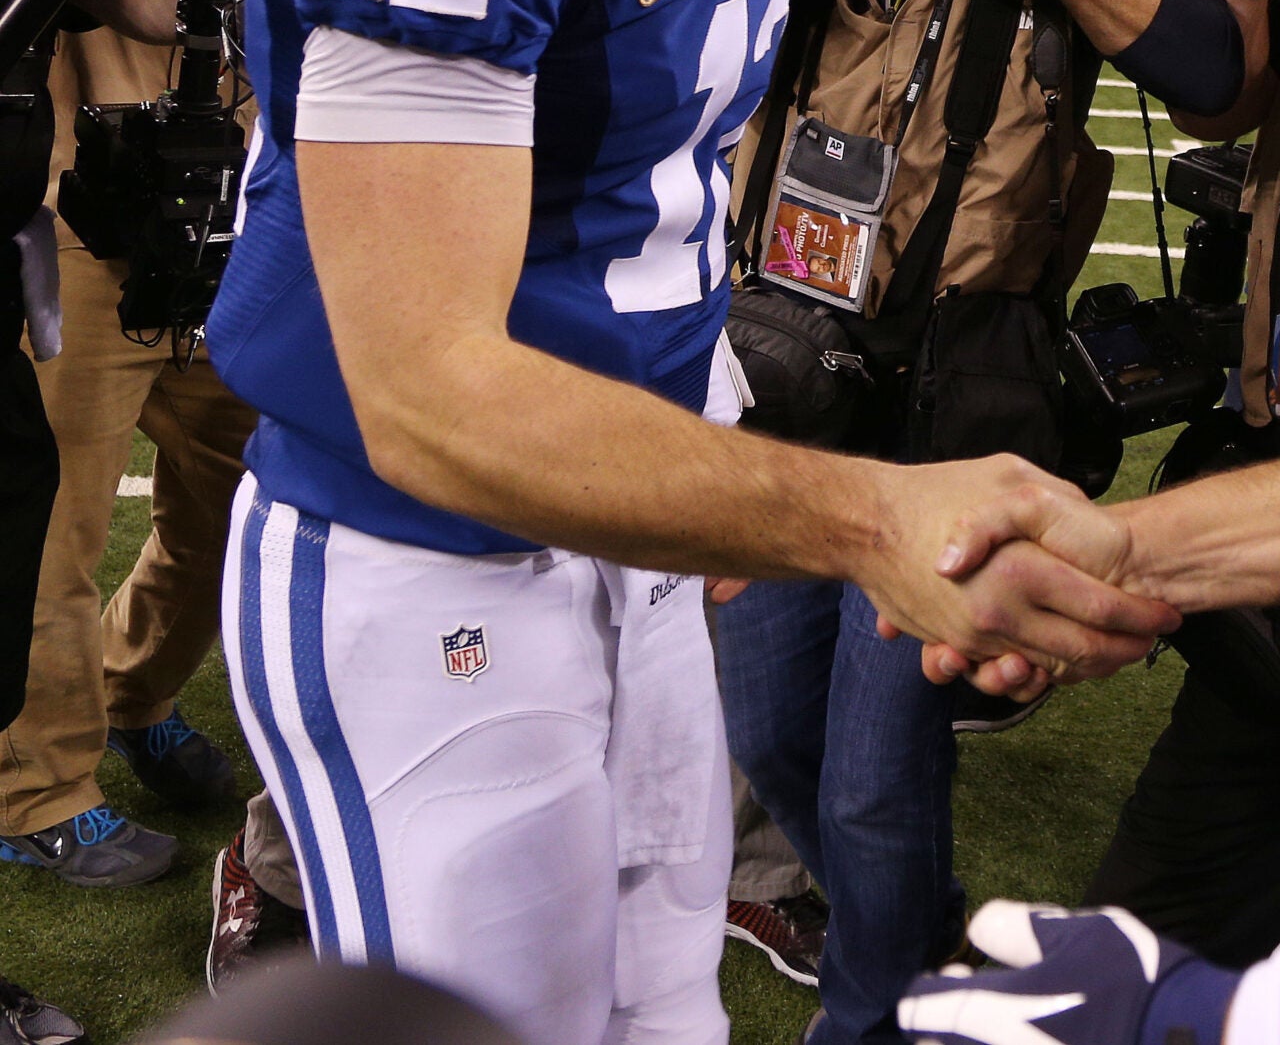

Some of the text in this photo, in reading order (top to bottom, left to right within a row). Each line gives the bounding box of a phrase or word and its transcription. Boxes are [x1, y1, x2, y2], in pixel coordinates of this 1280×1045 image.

[829, 139, 842, 150] AP
[797, 212, 811, 254] PHOTO/TV
[449, 646, 483, 673] NFL
